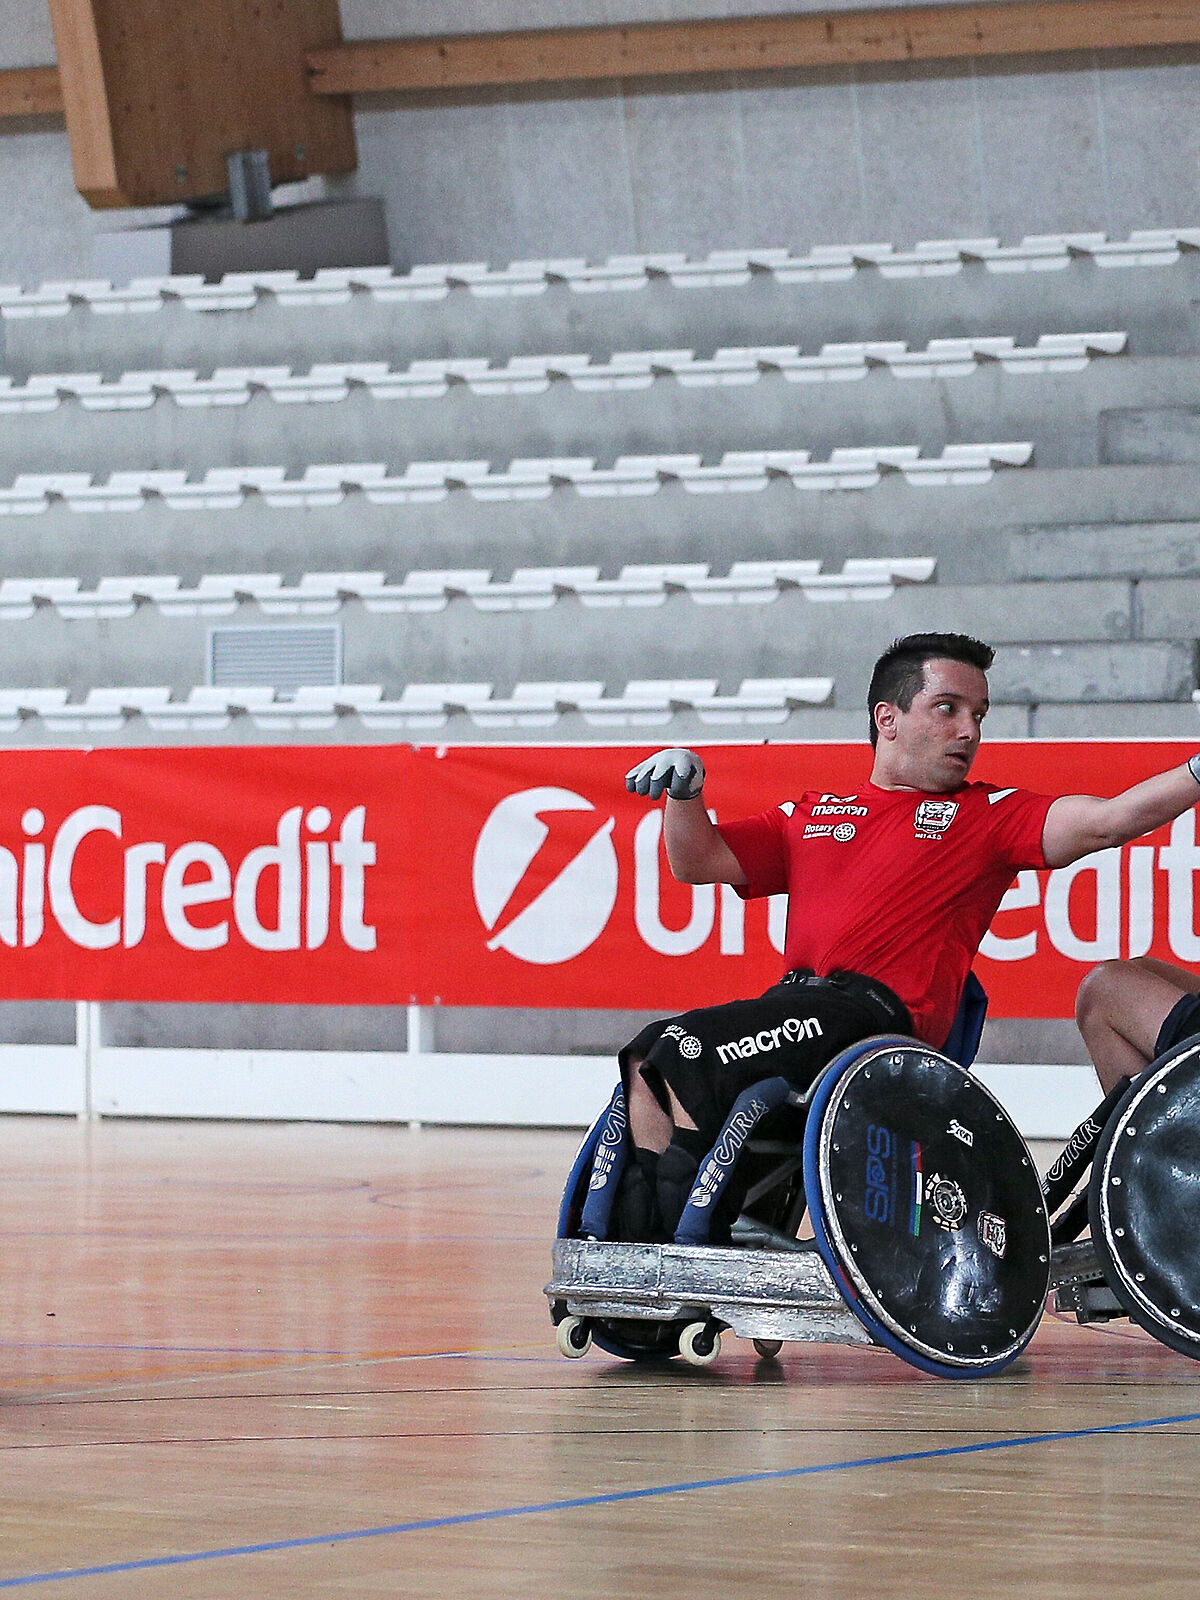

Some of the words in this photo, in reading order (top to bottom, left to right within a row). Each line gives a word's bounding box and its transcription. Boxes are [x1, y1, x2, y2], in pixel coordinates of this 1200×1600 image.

[804, 824, 835, 834] Rotary
[0, 805, 377, 952] iCredit
[715, 1017, 823, 1064] macron
